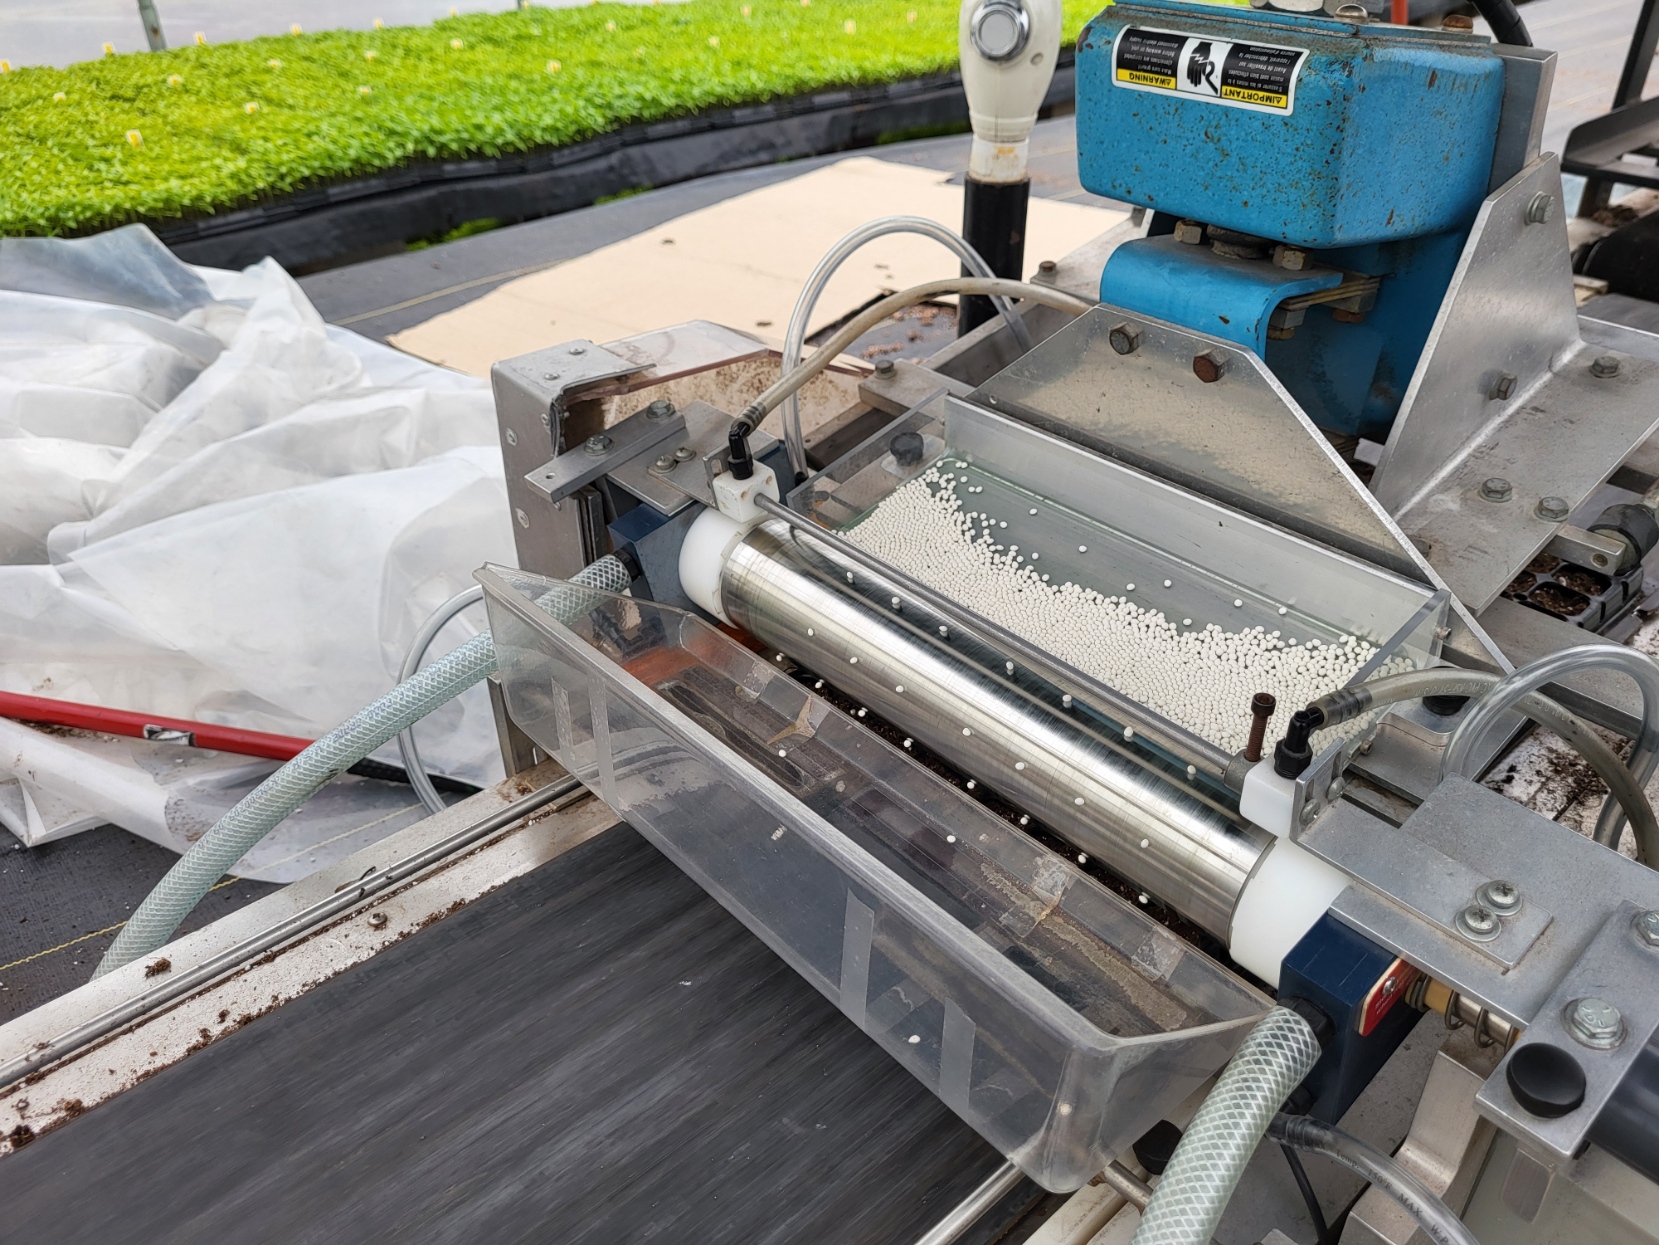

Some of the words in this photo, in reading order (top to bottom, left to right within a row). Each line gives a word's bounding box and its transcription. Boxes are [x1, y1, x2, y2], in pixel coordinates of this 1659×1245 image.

[1274, 66, 1287, 74] Avant
[1129, 72, 1166, 86] WARNING
[1223, 88, 1275, 104] IMPORTANT
[1397, 1192, 1423, 1220] MAX.
